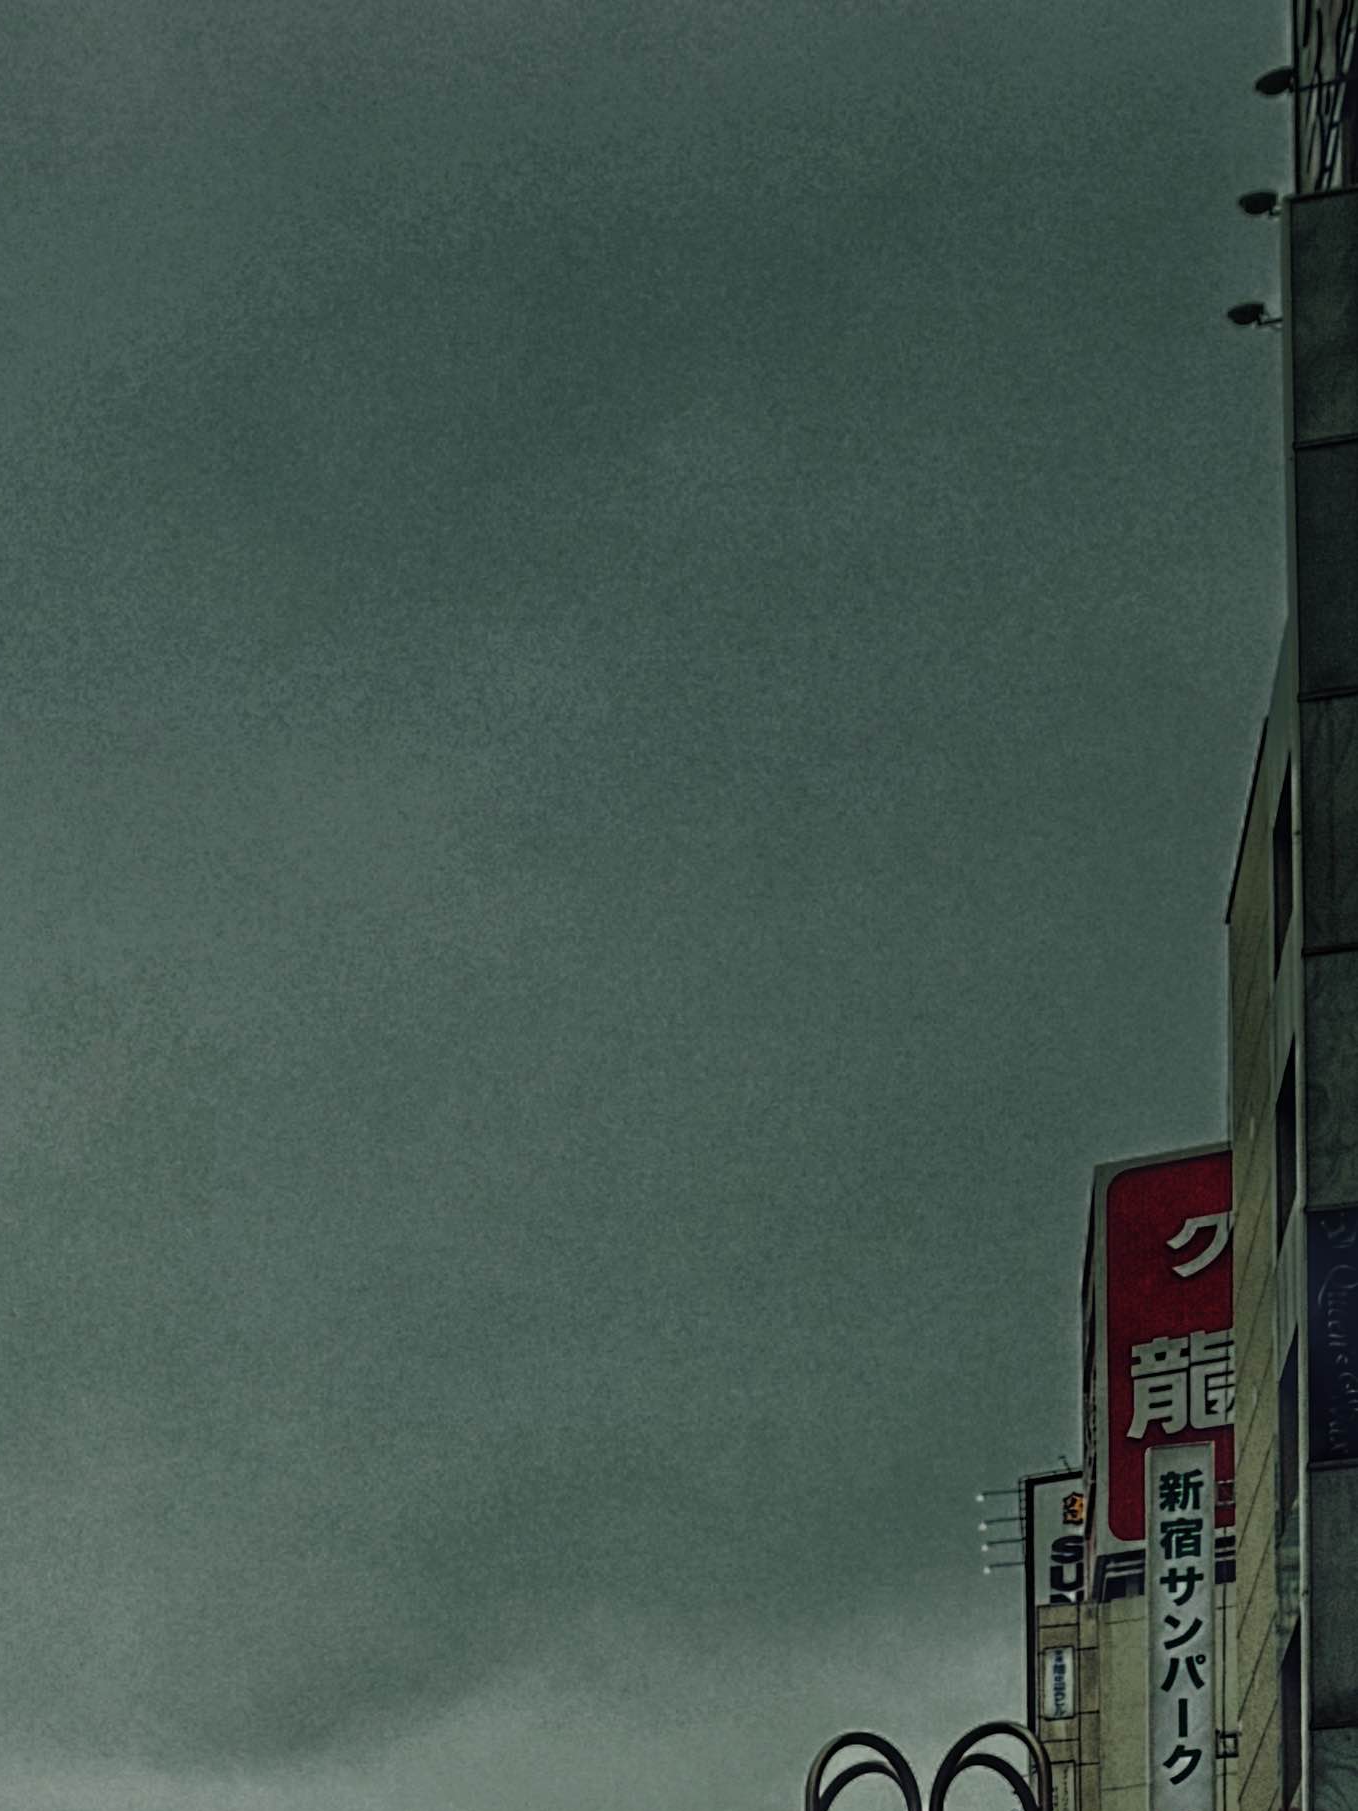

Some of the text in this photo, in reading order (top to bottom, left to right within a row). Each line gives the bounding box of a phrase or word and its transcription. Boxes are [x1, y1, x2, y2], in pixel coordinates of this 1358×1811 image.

[1157, 1466, 1206, 1789] 新宿サンパーク
